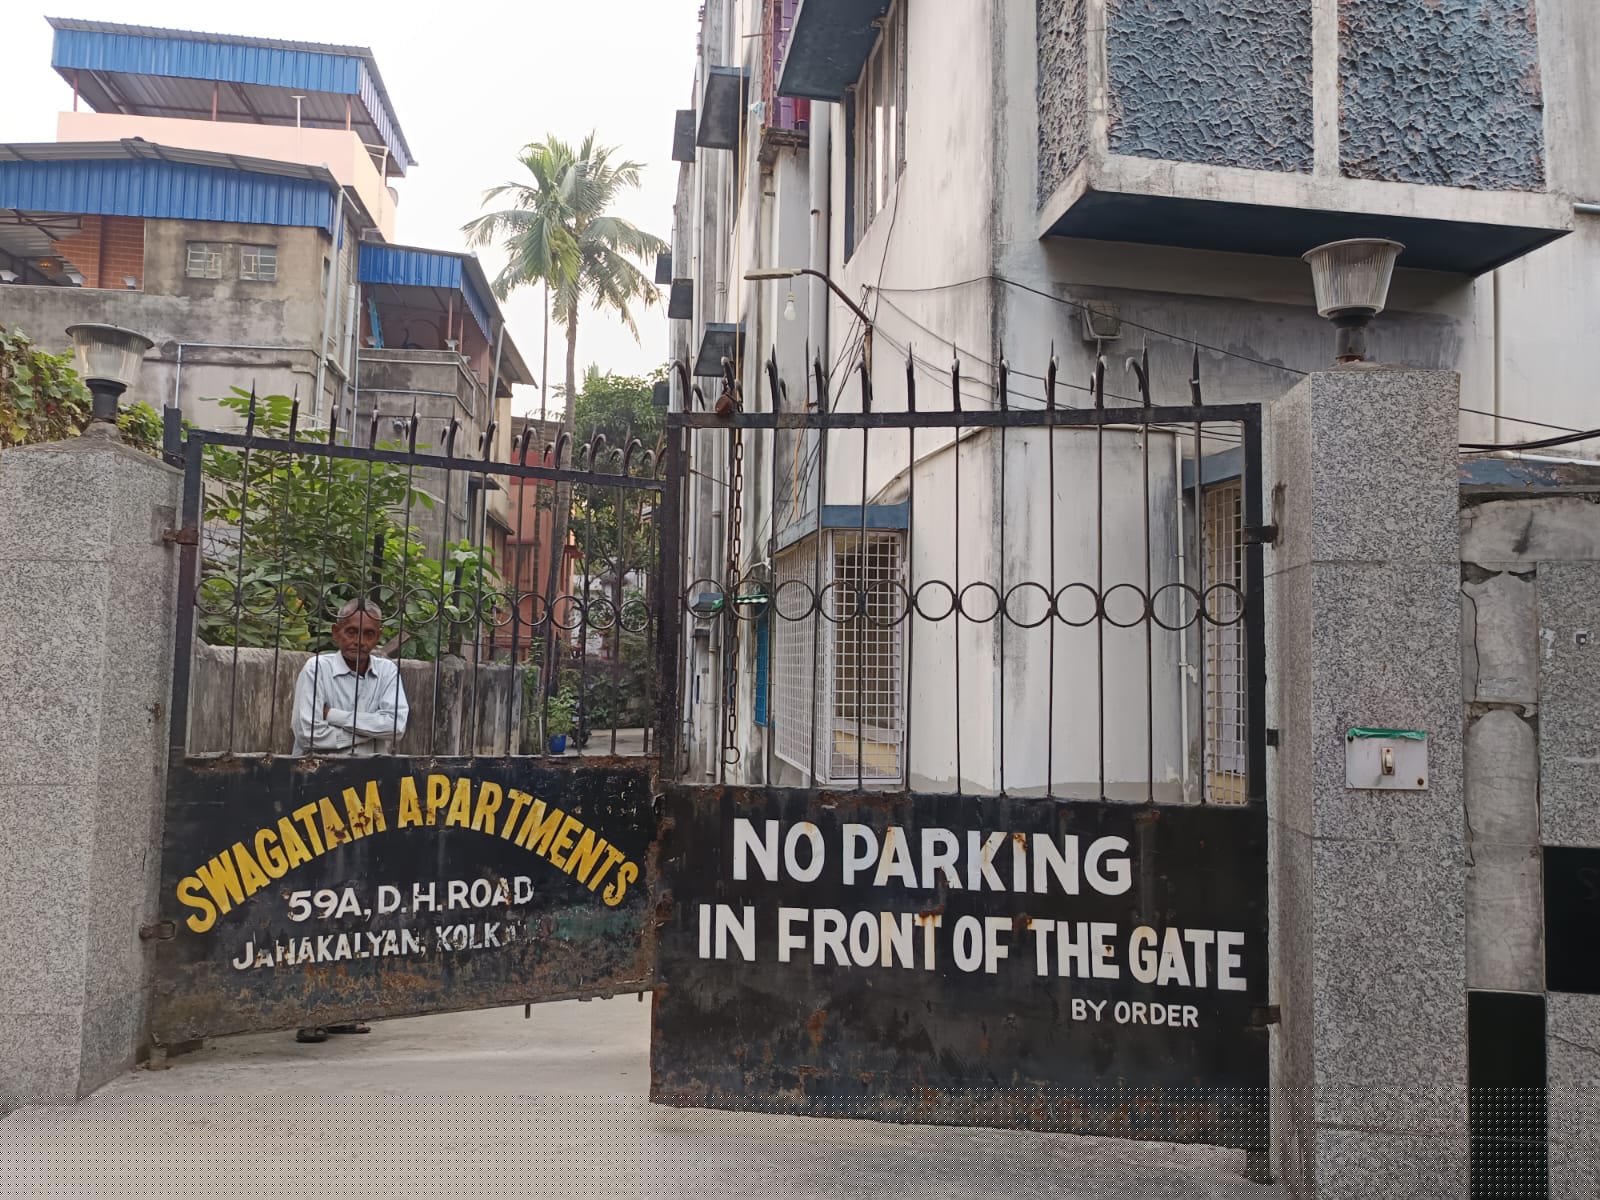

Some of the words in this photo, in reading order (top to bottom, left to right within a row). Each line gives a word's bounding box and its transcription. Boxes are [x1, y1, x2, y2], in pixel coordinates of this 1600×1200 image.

[176, 780, 386, 933] SWAGATAM
[397, 774, 640, 907] APARTMENTS
[732, 817, 826, 883] NO
[842, 822, 1132, 896] PARKING
[698, 903, 756, 962] IN
[778, 907, 942, 971] FRONT
[952, 915, 1013, 975] OF
[1028, 918, 1120, 980] THE
[1128, 926, 1248, 992] GATE
[1071, 998, 1107, 1022] BY
[1114, 1000, 1199, 1029] ORDER
